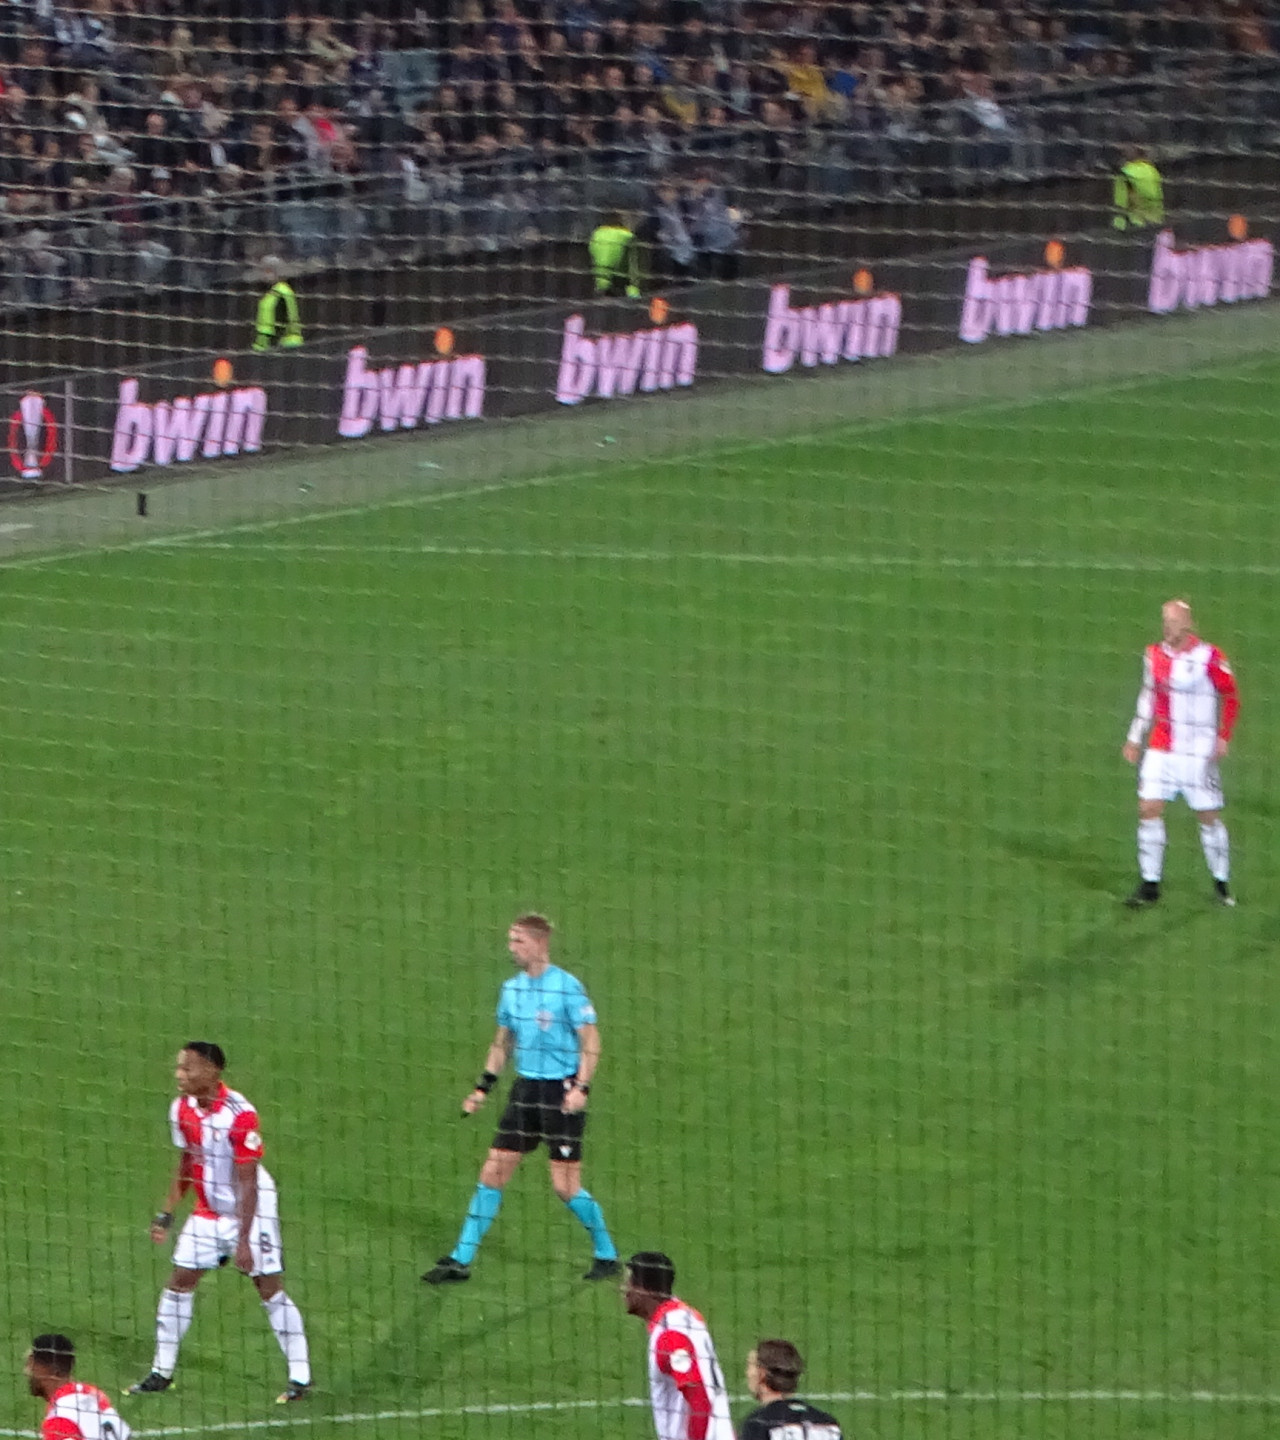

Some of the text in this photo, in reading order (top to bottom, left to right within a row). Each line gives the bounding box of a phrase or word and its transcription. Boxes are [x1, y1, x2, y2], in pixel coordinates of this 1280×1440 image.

[959, 240, 1093, 343] bwin
[1148, 214, 1275, 314] bwin
[556, 297, 699, 405] bwin
[762, 268, 902, 374] bwin
[109, 358, 268, 472] bwin
[338, 326, 485, 438] bwin
